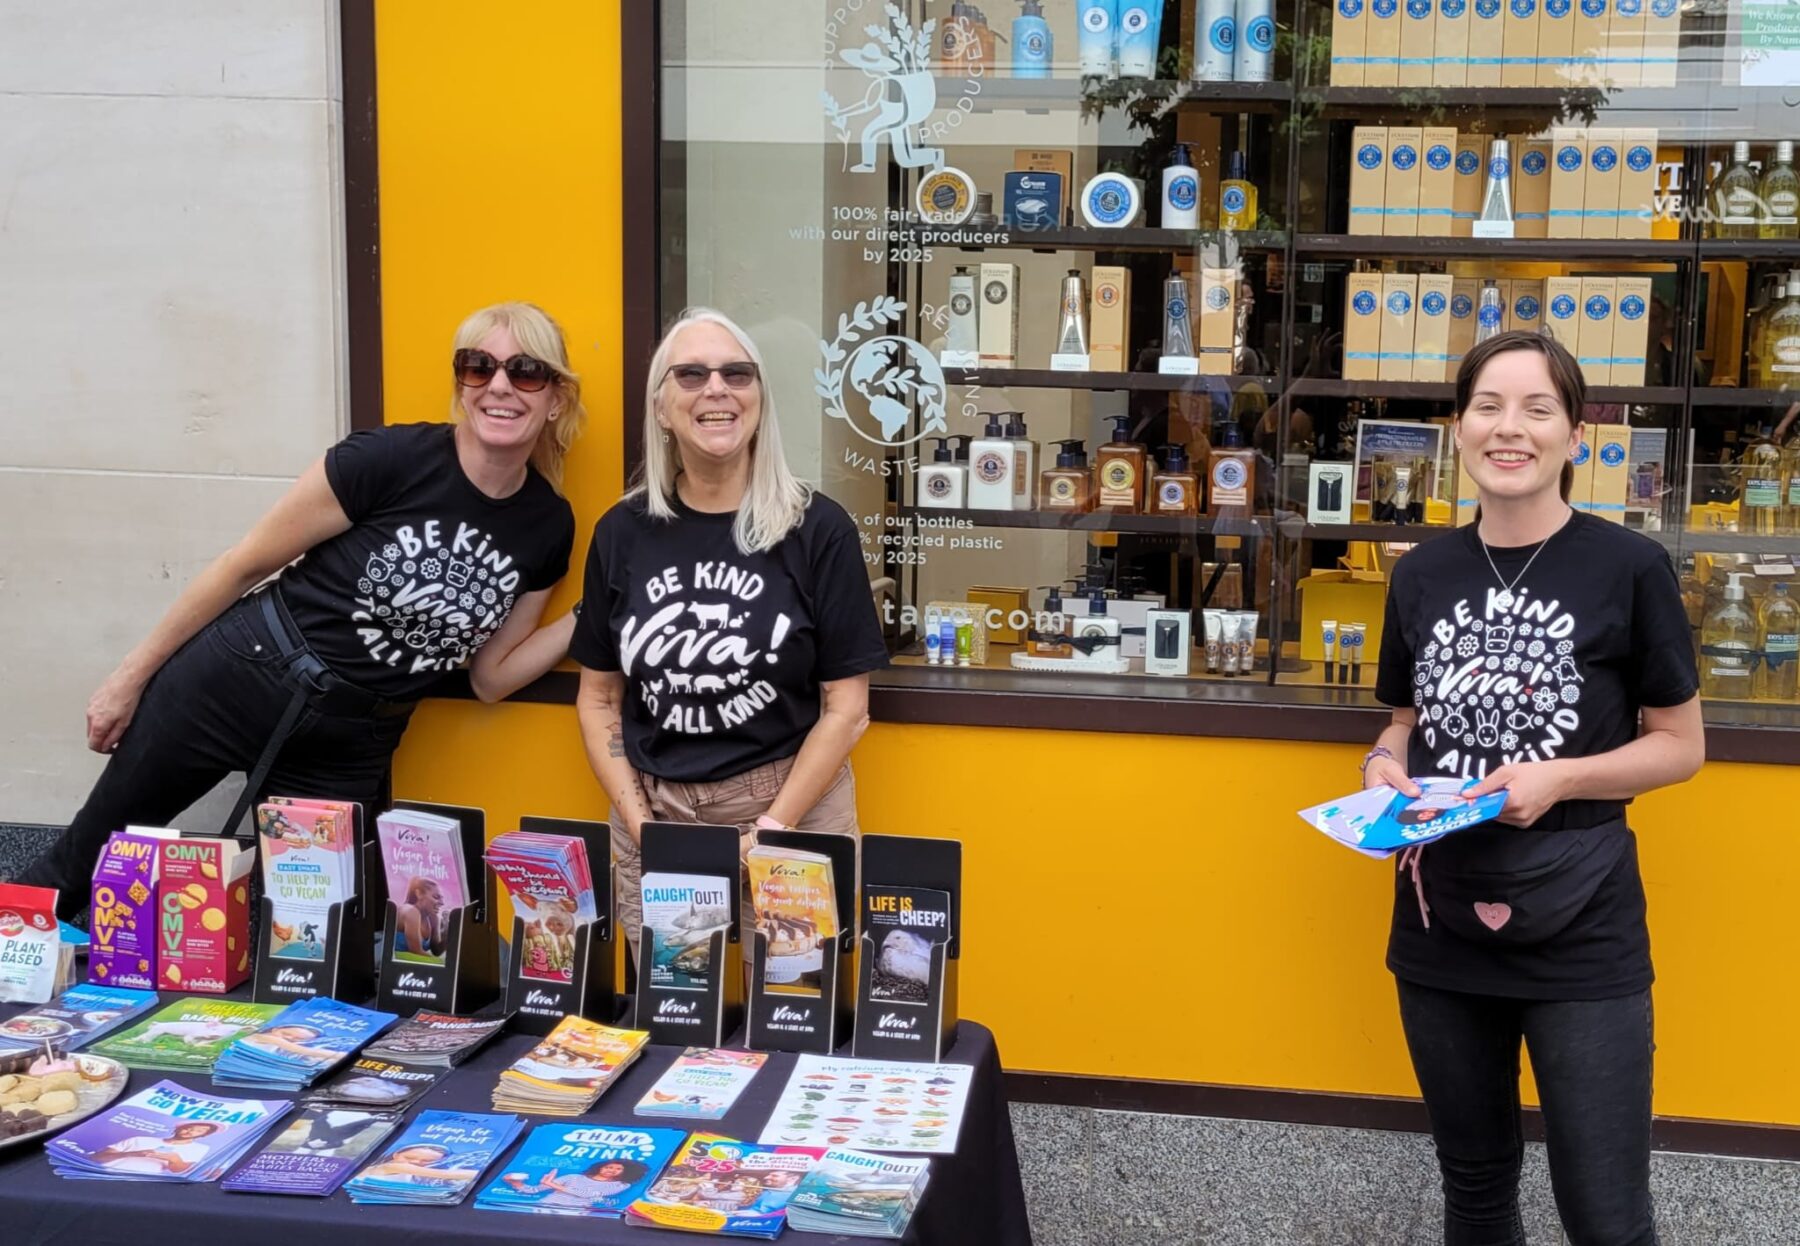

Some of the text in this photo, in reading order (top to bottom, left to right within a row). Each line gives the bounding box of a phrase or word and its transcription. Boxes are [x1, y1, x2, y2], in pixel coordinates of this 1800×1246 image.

[918, 16, 983, 143] PRODUCERS
[832, 206, 878, 221] 100%
[788, 227, 1009, 247] with our direct producers
[863, 248, 933, 264] by 2025
[919, 303, 981, 418] RECING
[843, 447, 920, 477] WASTE
[864, 513, 880, 527] of
[885, 515, 913, 528] our
[917, 513, 974, 530] bottles
[396, 520, 442, 558] BE
[877, 533, 945, 550] recycled
[950, 534, 1003, 551] plastic
[863, 551, 927, 566] by 2025
[645, 566, 684, 604] BE
[391, 578, 496, 634] Viva!
[1433, 598, 1473, 646] BE
[619, 601, 791, 677] Viva!
[1436, 656, 1545, 701] Viva!
[661, 704, 713, 734] ALL
[716, 680, 778, 729] KIND
[397, 829, 430, 844] Viva!
[111, 839, 152, 860] OMV!
[165, 844, 217, 863] OMV!
[393, 847, 423, 863] Vegan
[418, 861, 449, 881] health
[770, 864, 805, 877] Viva!
[271, 872, 331, 887] TO HELP YOU
[280, 886, 326, 900] GO VEGAN
[644, 888, 724, 905] CAUGHT OUT!
[869, 896, 912, 912] LIFE IS
[899, 910, 946, 927] CHEEP?
[1, 952, 43, 966] BASED
[275, 967, 313, 984] Viva!
[399, 972, 433, 988] Viva!
[526, 989, 560, 1006] Viva!
[659, 998, 696, 1014] Viva!
[773, 1005, 810, 1021] Viva!
[879, 1012, 916, 1029] Viva!
[354, 1059, 404, 1073] LIFE IS
[154, 1087, 223, 1109] HOW TO
[147, 1096, 173, 1111] GO
[171, 1103, 264, 1125] VEGAN
[575, 1131, 646, 1145] THINK
[259, 1154, 326, 1163] MOTHERS
[552, 1144, 635, 1161] DRINK
[249, 1163, 296, 1171] BABIES
[695, 1158, 736, 1173] 25
[826, 1151, 920, 1175] CAUGHT OUT!
